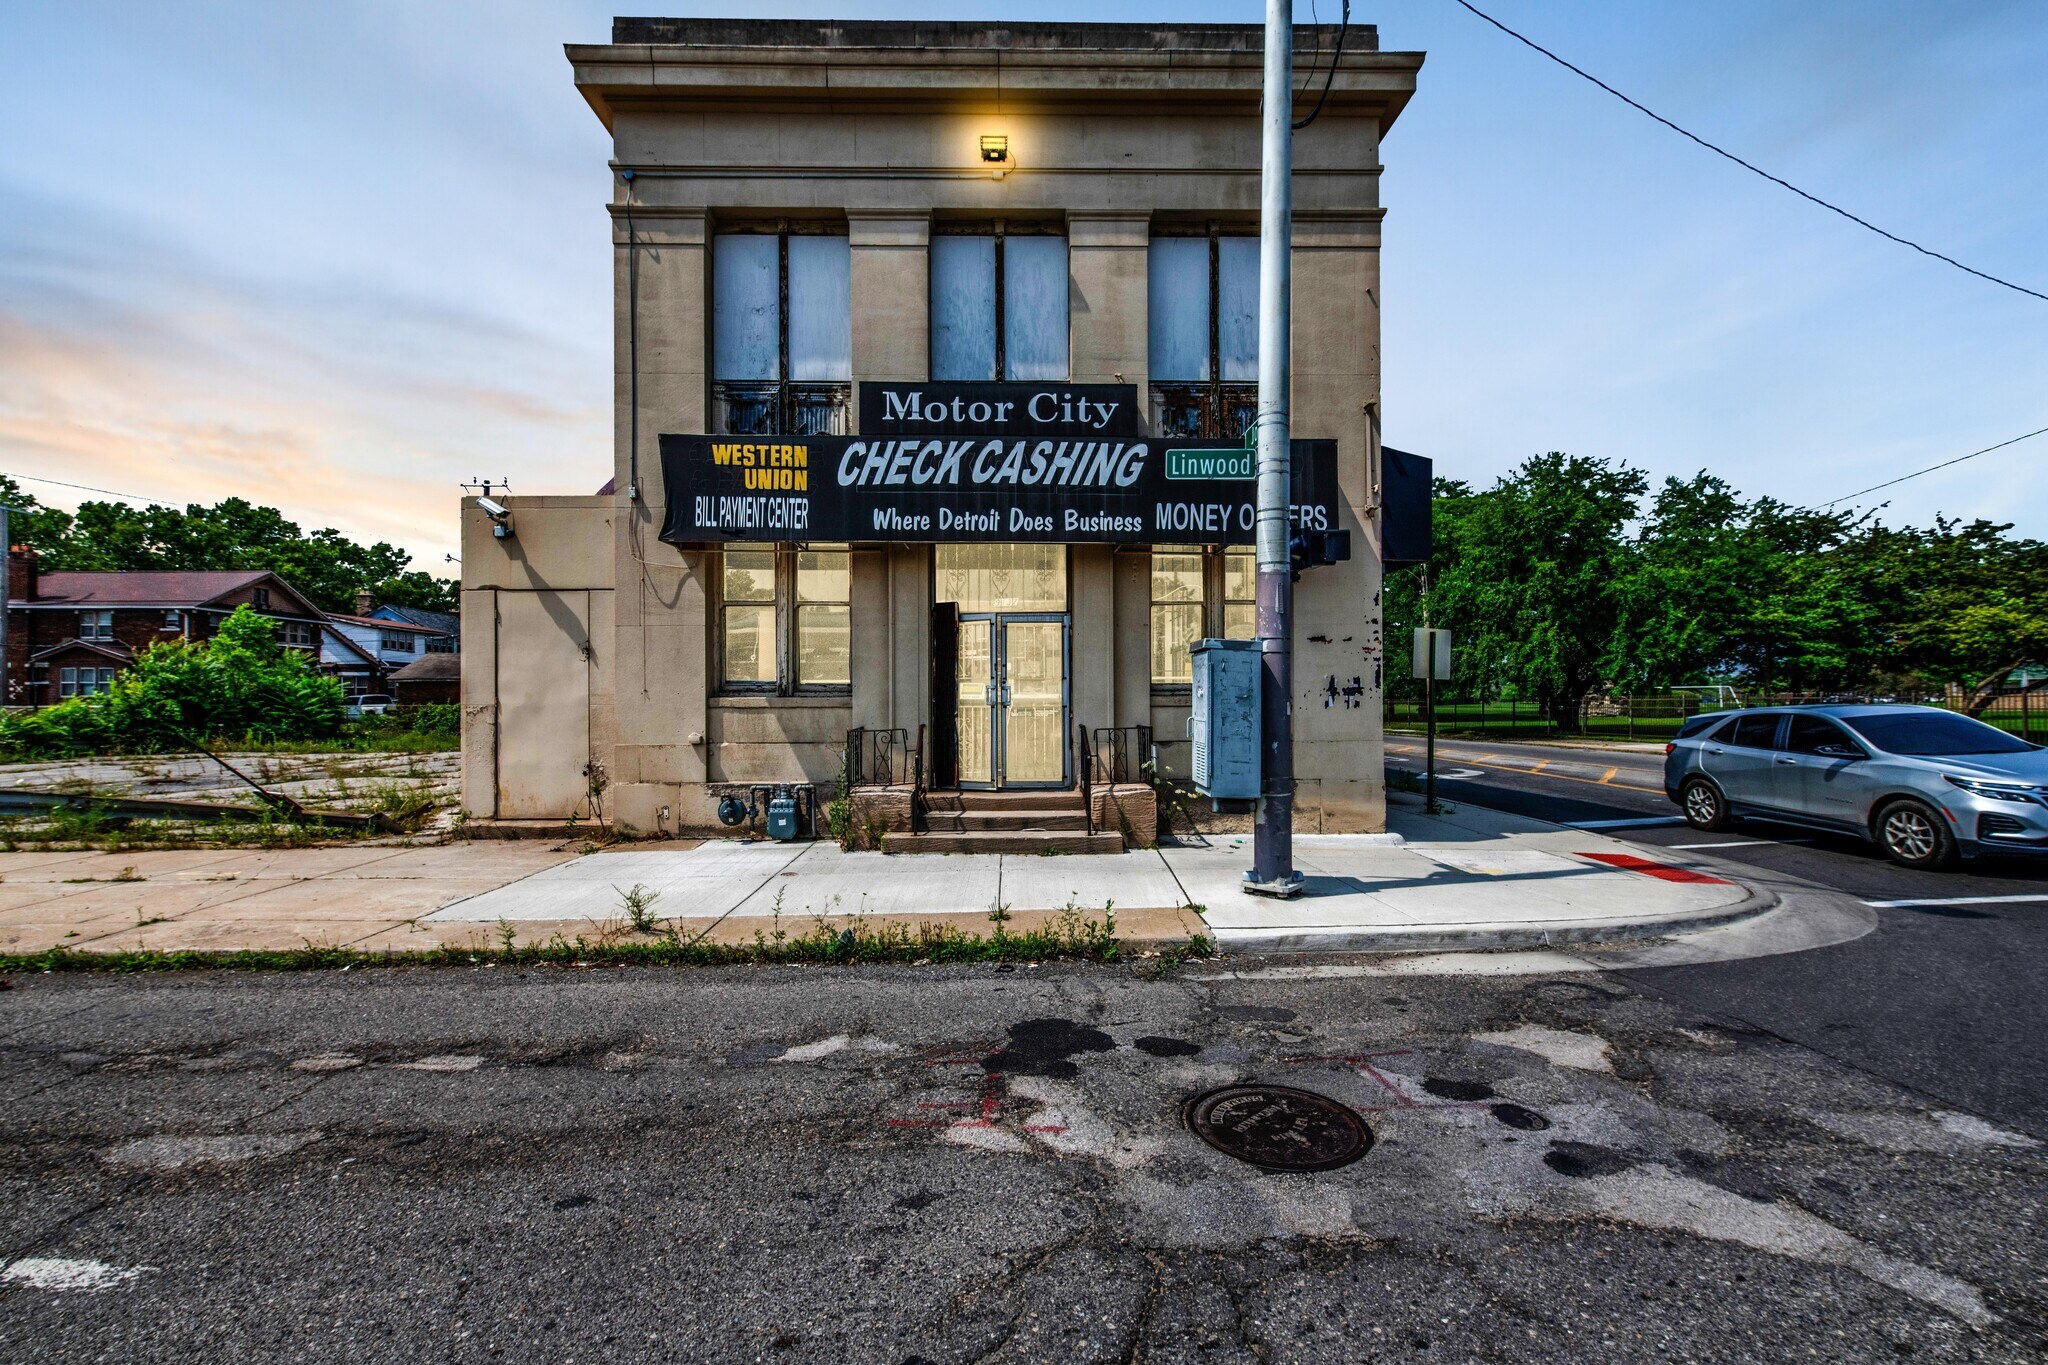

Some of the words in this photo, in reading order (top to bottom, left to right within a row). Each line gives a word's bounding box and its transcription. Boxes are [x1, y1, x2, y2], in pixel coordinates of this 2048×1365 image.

[882, 391, 1015, 422] Motor
[1028, 392, 1119, 429] City
[711, 444, 808, 468] WESTERN
[837, 440, 975, 487] CHECK
[972, 440, 1148, 488] CASHING
[1171, 454, 1250, 475] Linwood
[744, 468, 808, 491] UNION
[695, 496, 717, 528] BILL
[719, 496, 767, 529] PAYMENT
[767, 497, 809, 529] CENTER
[873, 507, 930, 531] Where
[939, 507, 1000, 532] Detroit
[1009, 507, 1053, 532] Does
[1065, 508, 1142, 532] Business
[1156, 503, 1232, 531] MONEY
